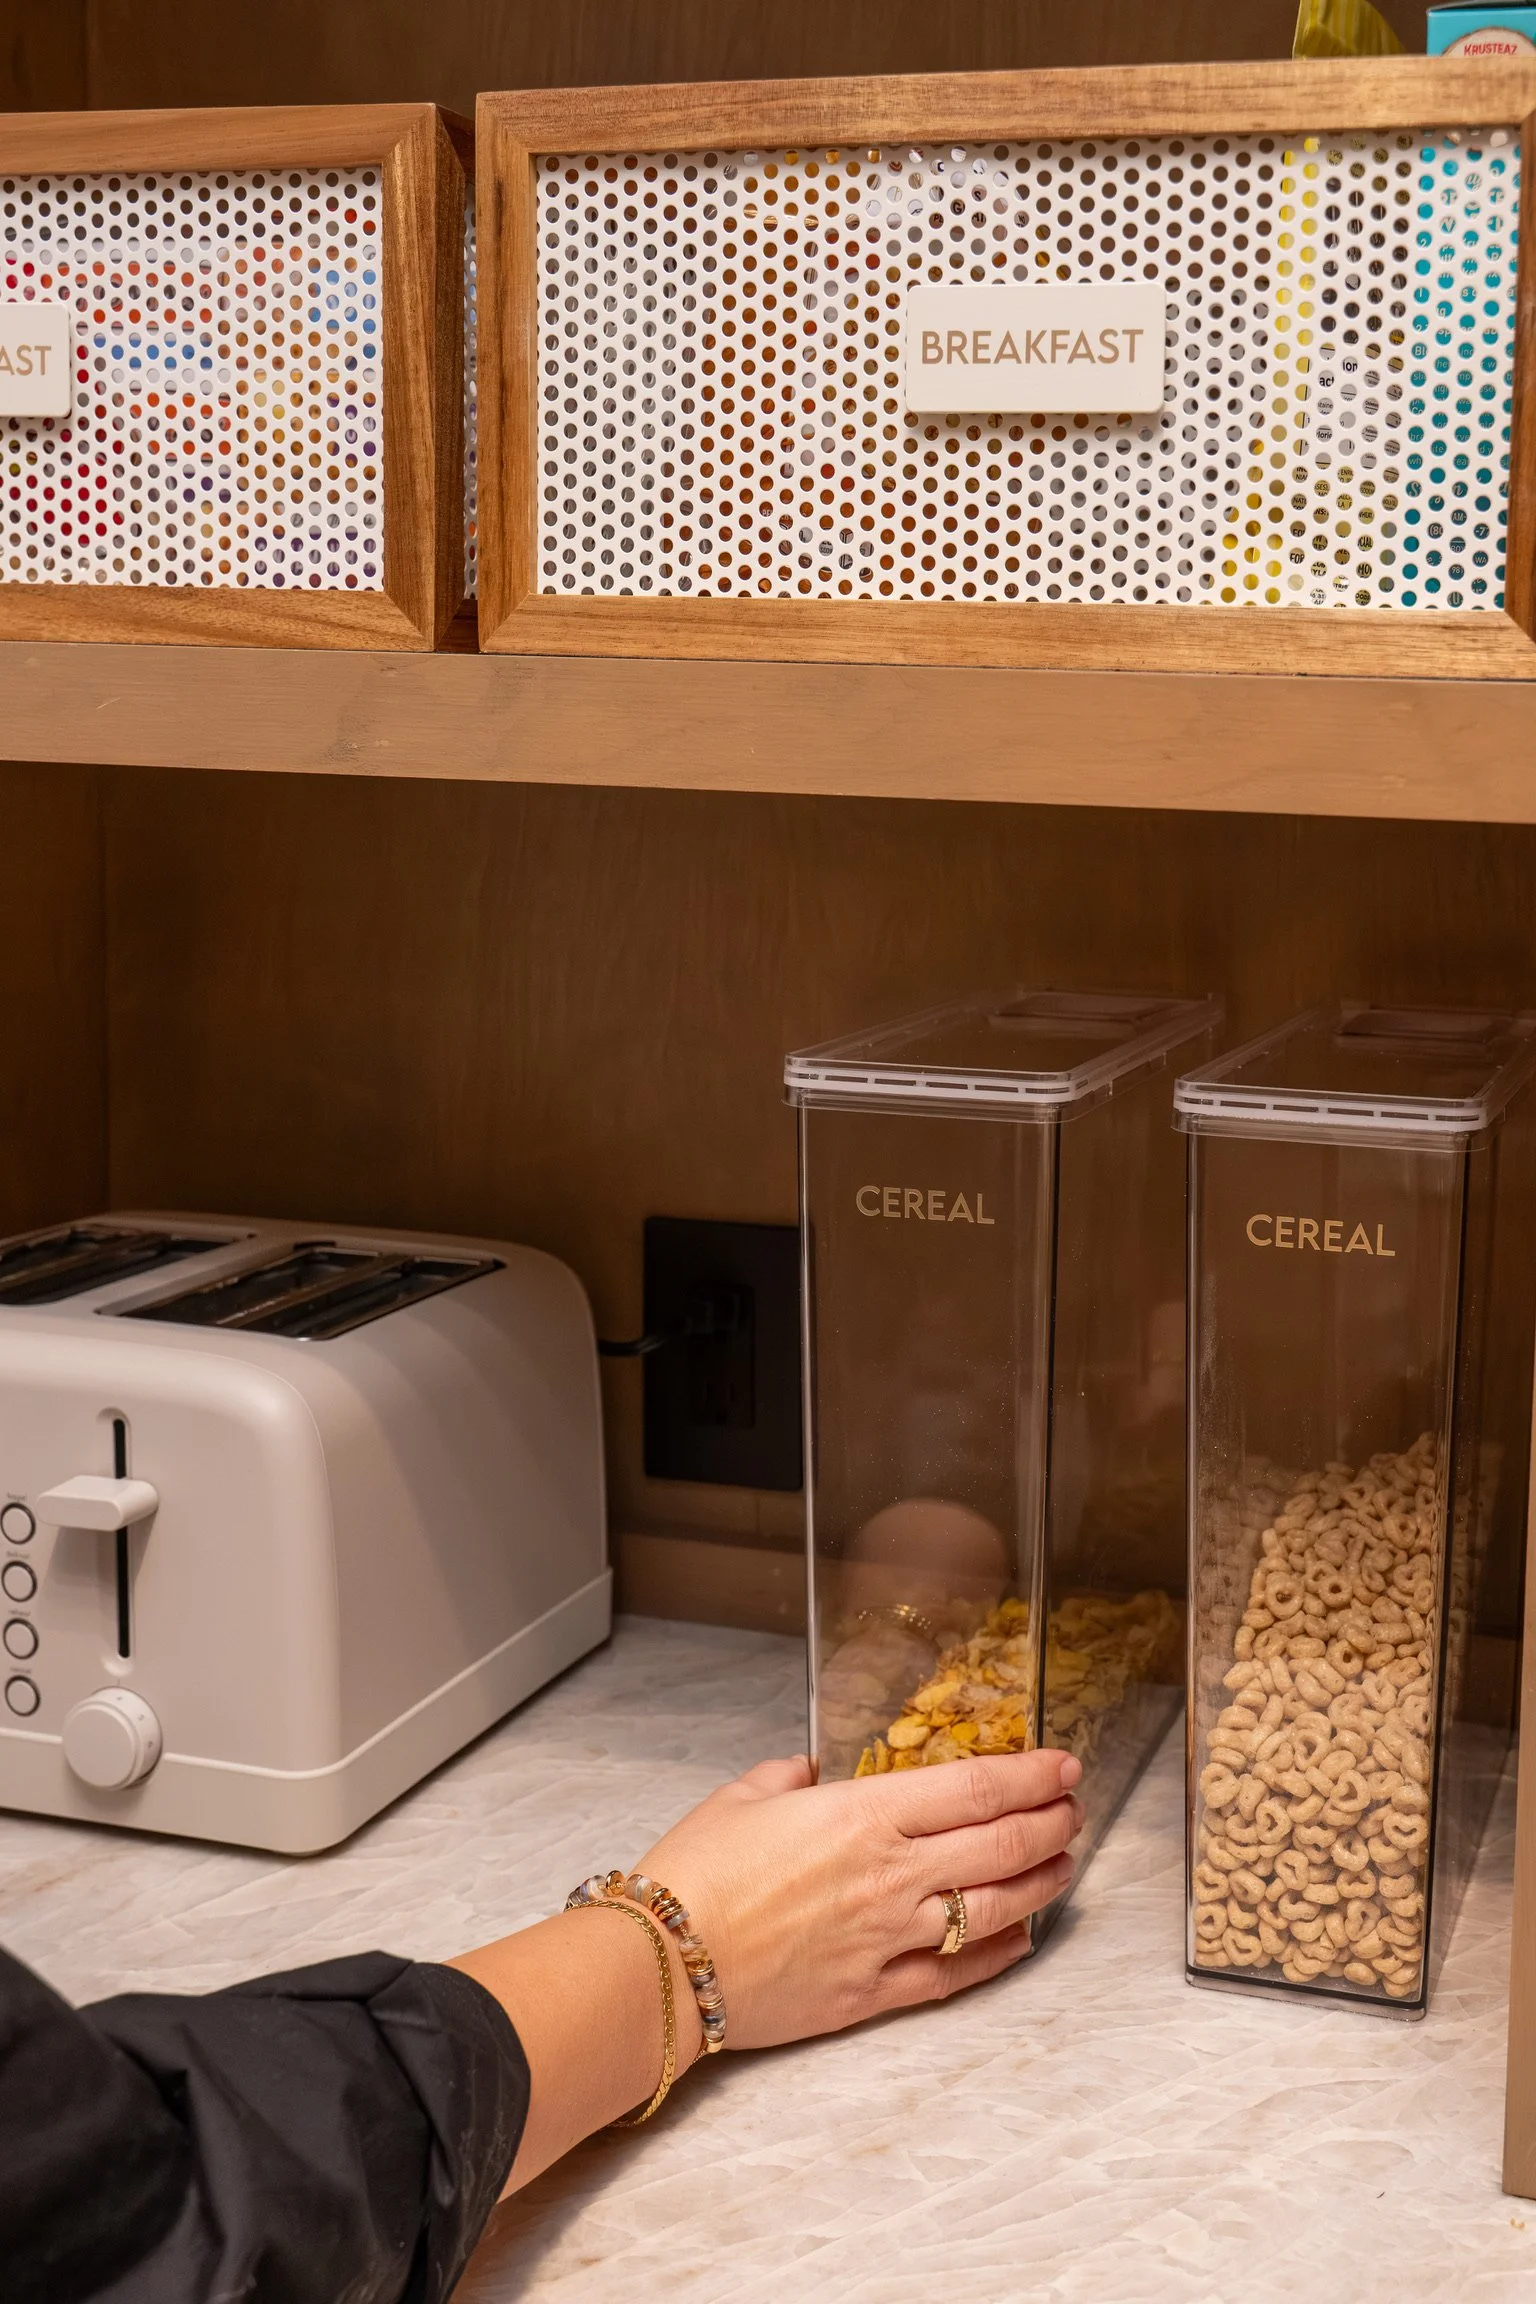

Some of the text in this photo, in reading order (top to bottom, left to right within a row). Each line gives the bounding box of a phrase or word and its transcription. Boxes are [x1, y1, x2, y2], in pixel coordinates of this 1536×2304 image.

[1464, 43, 1518, 55] KRUSTEAZ
[921, 328, 1144, 365] BREAKFAST
[855, 1185, 996, 1226] CEREAL
[1245, 1213, 1396, 1258] CEREAL
